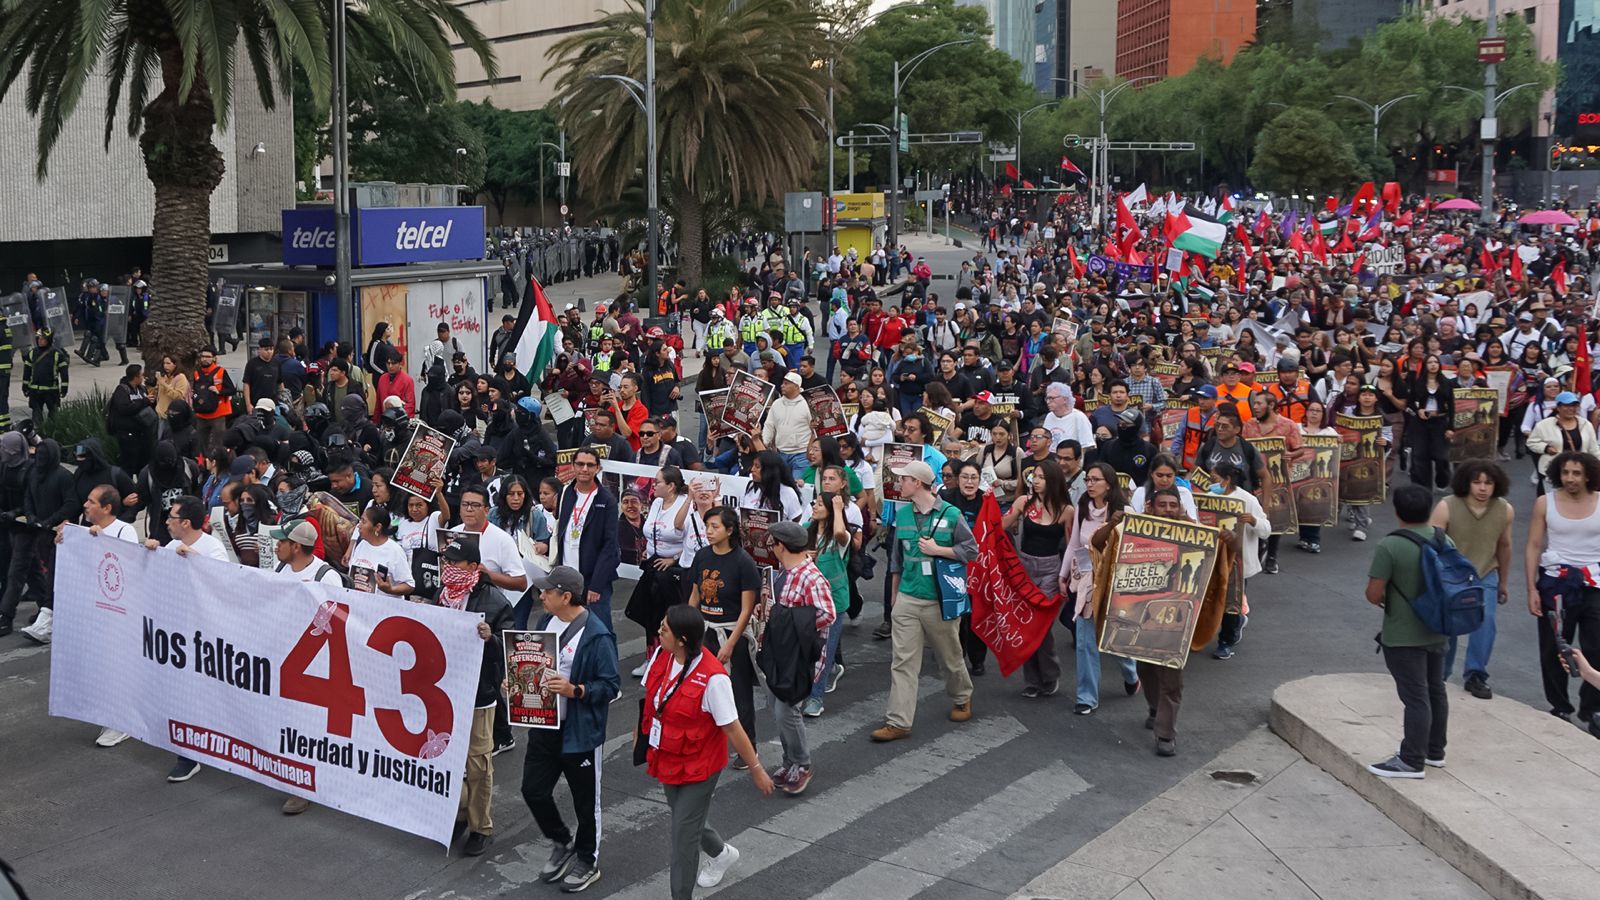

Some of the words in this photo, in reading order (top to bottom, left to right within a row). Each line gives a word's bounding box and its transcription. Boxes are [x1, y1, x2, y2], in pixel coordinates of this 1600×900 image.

[292, 226, 336, 249] telce
[396, 219, 453, 250] telcel
[428, 303, 450, 319] Fue
[1301, 436, 1339, 448] ZINAPA
[1194, 496, 1244, 513] TZINAPA
[1125, 517, 1215, 548] AYOTZINAPA
[1122, 542, 1135, 553] 12
[1148, 566, 1159, 576] EL
[1156, 606, 1176, 624] 43
[143, 615, 187, 669] Nos
[193, 630, 271, 696] faltan
[279, 600, 454, 759] 43
[529, 715, 546, 724] AÑOS
[172, 723, 184, 743] La
[186, 727, 208, 749] Red
[209, 733, 231, 756] TDT
[231, 743, 251, 763] con
[252, 748, 312, 786] Ayotzinapa
[280, 727, 353, 769] ¡Verdad
[358, 749, 369, 775] y
[372, 749, 451, 798] justicia!
